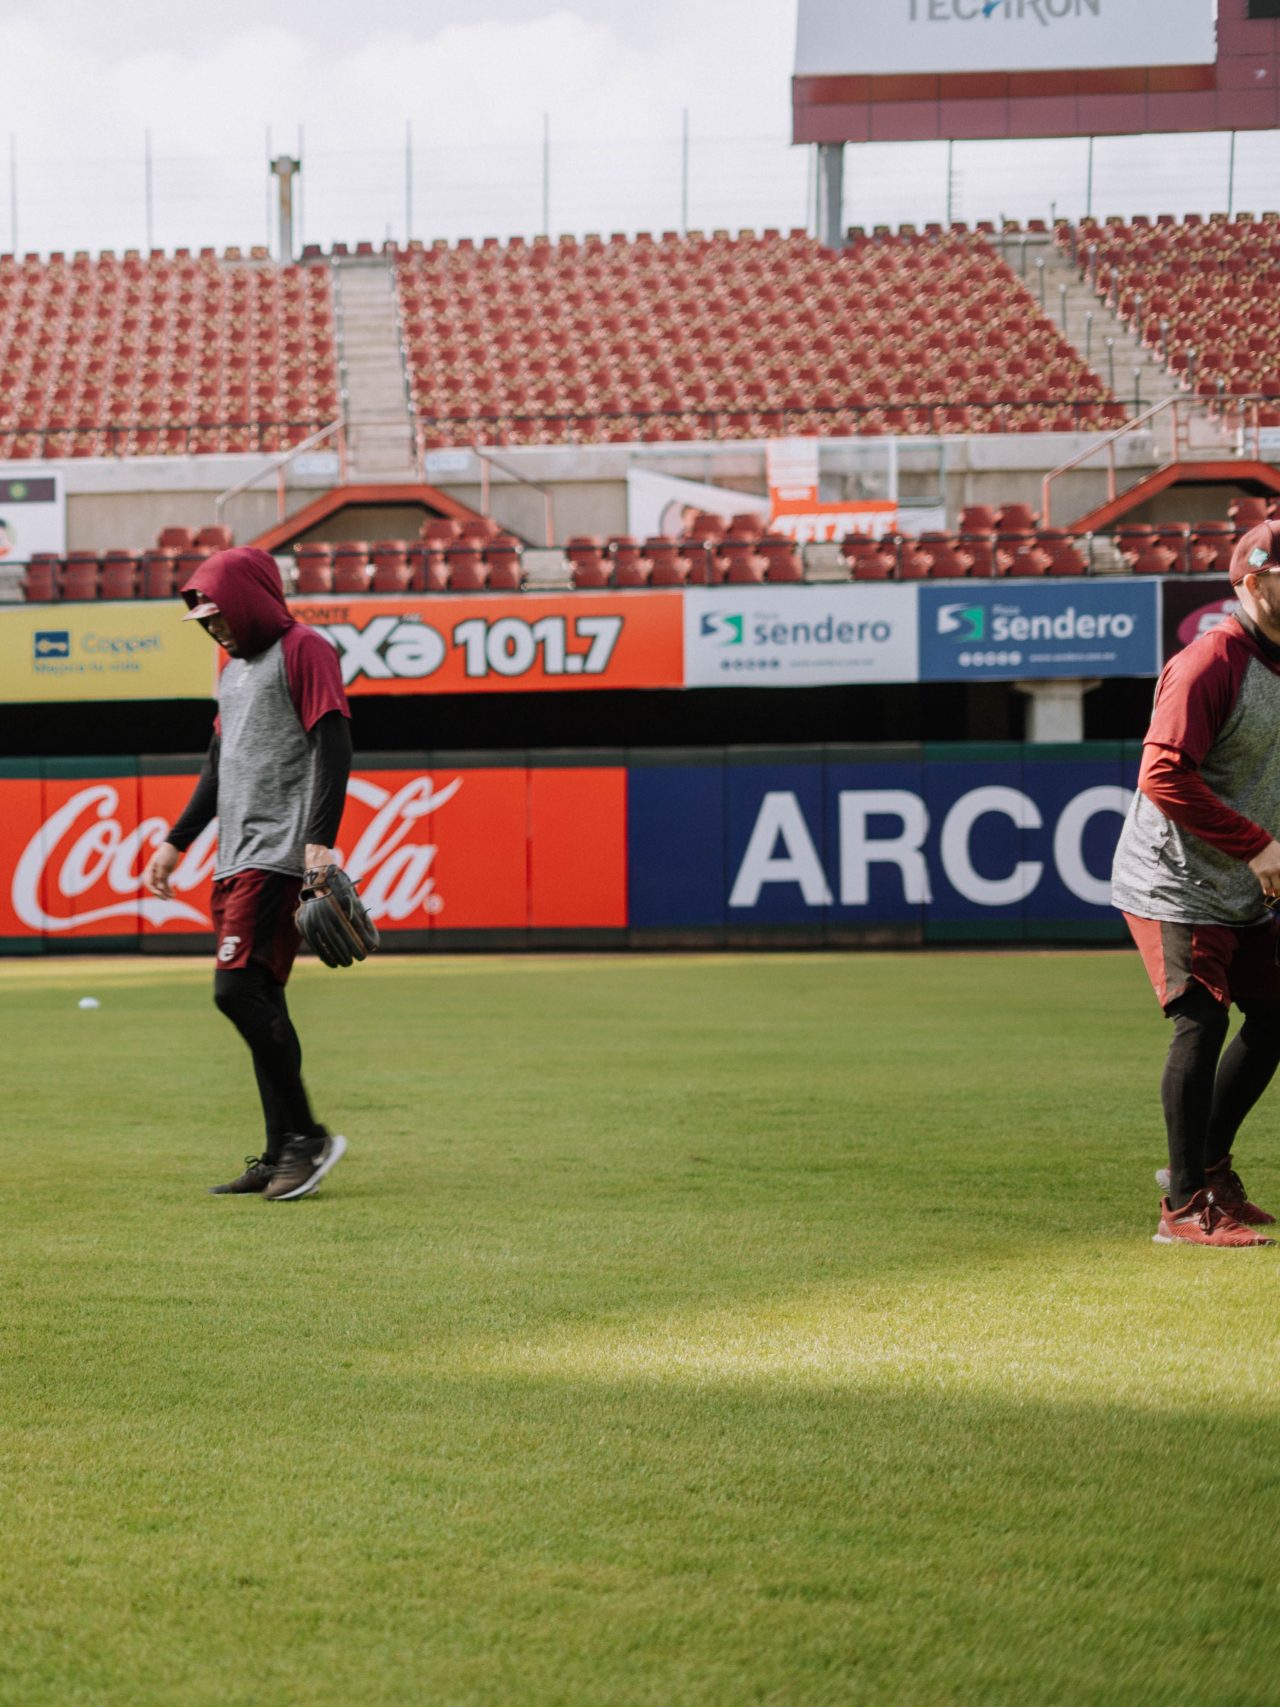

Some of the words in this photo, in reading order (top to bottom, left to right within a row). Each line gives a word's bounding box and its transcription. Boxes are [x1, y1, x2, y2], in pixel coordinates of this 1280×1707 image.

[754, 615, 892, 646] sendero
[992, 606, 1135, 641] sendero
[313, 613, 447, 688] xa
[453, 615, 624, 678] 101.7
